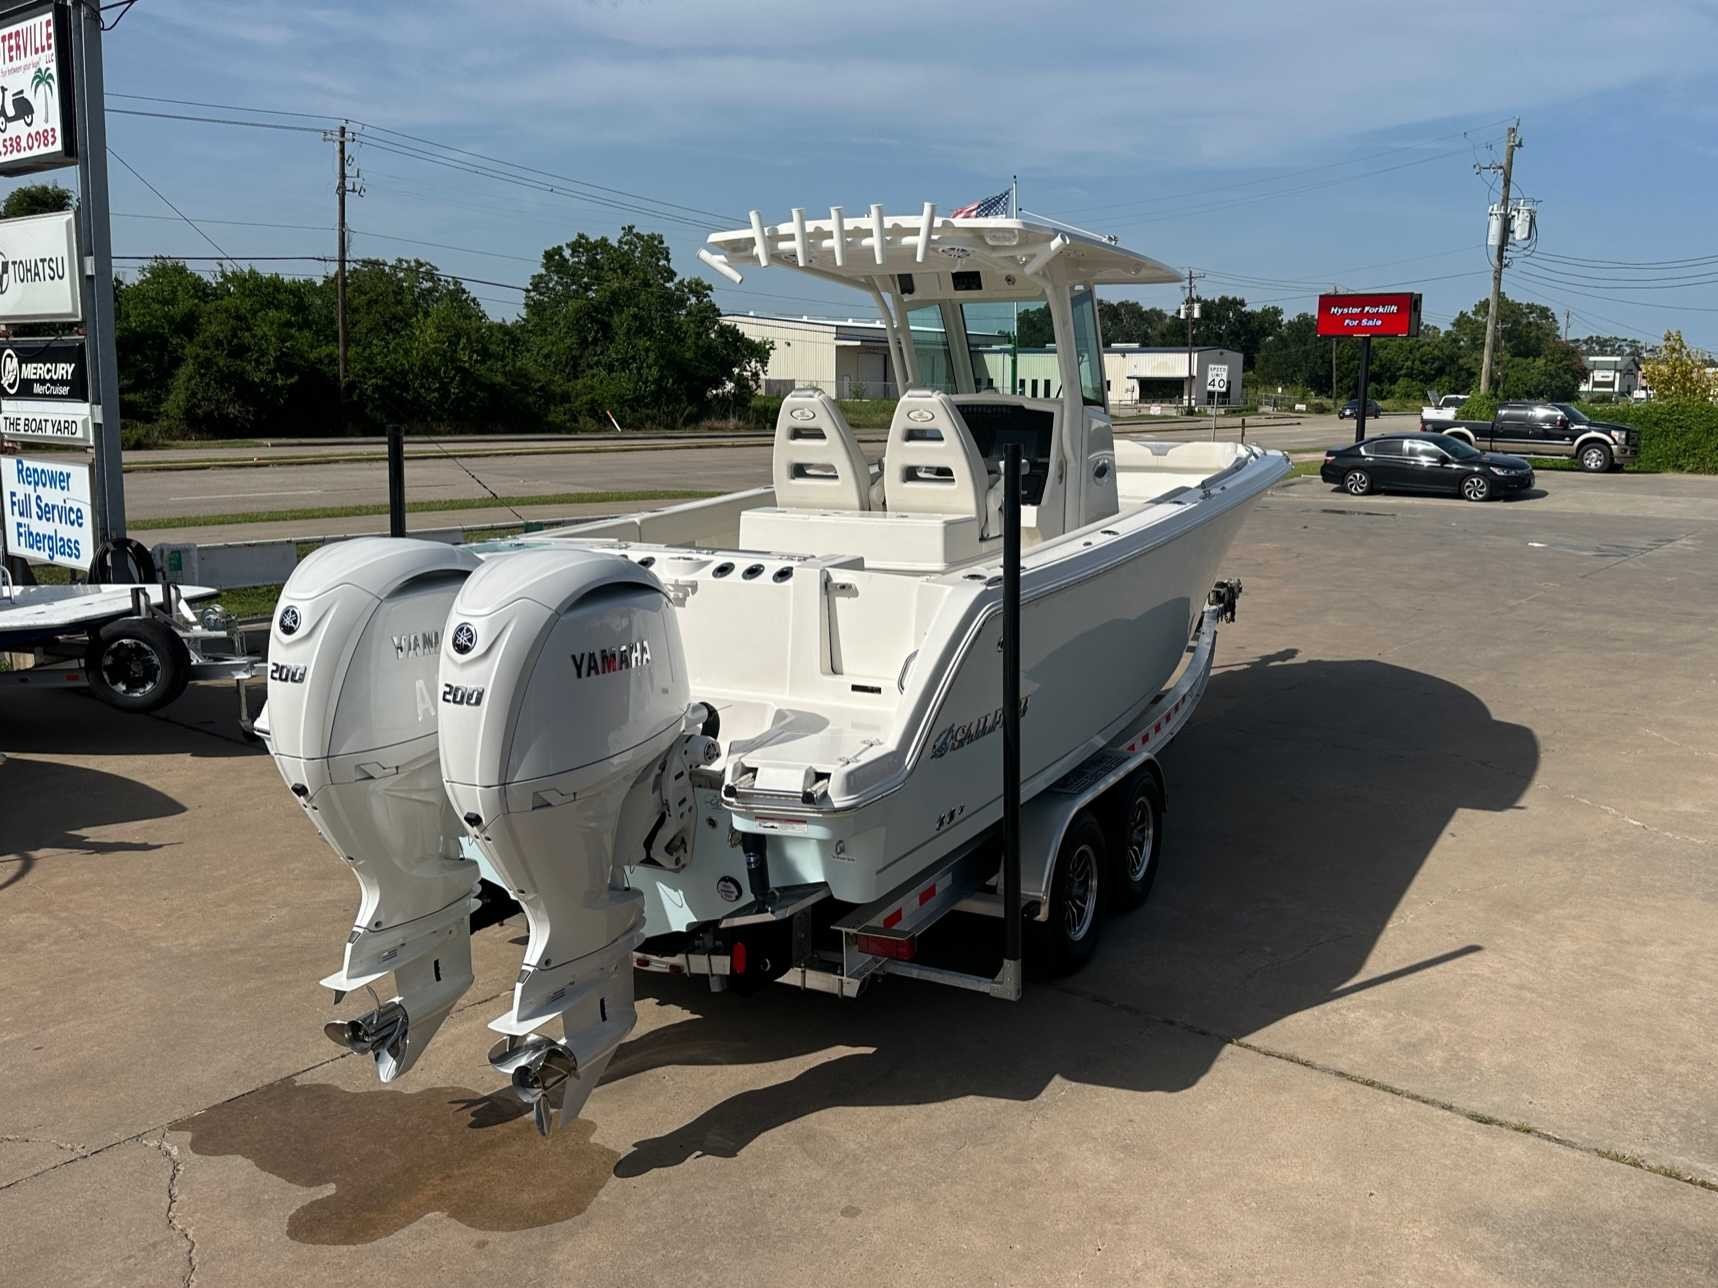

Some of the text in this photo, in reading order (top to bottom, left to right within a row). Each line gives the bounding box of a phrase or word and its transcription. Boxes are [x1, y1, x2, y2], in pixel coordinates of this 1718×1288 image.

[0, 19, 52, 65] TERVILLE
[11, 256, 66, 284] TOHATSU
[1330, 304, 1398, 316] Hyster Forklift
[1344, 318, 1382, 327] For Sale
[21, 362, 76, 381] MERCURY
[1208, 377, 1225, 389] 40
[33, 382, 71, 396] MerCruiser
[3, 416, 78, 437] THE BOAT YARD
[16, 458, 72, 492] Repower
[10, 490, 84, 529] Full Service
[16, 521, 82, 561] Fiberglass
[570, 639, 652, 680] YAMAHA
[270, 662, 308, 684] 200
[442, 682, 485, 707] 200
